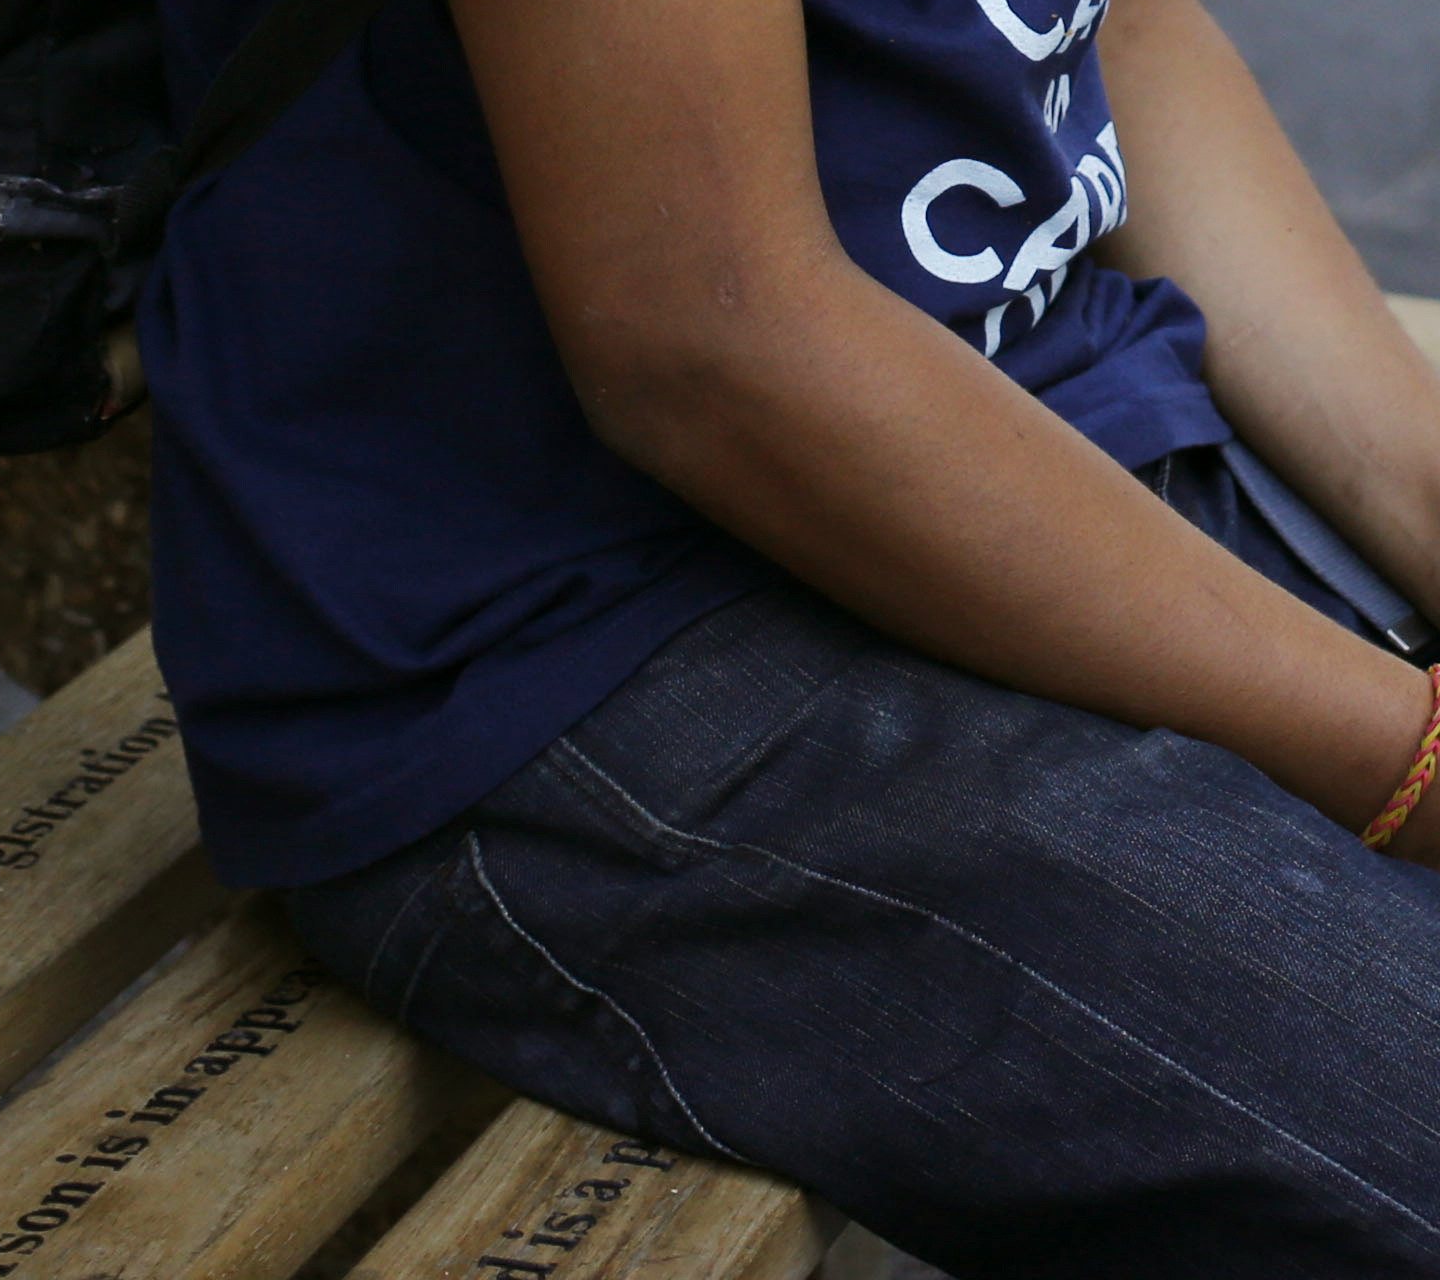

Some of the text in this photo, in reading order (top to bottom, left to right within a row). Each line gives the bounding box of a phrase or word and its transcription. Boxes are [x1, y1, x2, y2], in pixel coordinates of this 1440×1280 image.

[56, 1134, 150, 1171] is
[105, 1085, 207, 1126] in
[184, 958, 328, 1075] appea
[502, 1211, 597, 1252] is
[575, 1178, 631, 1202] a
